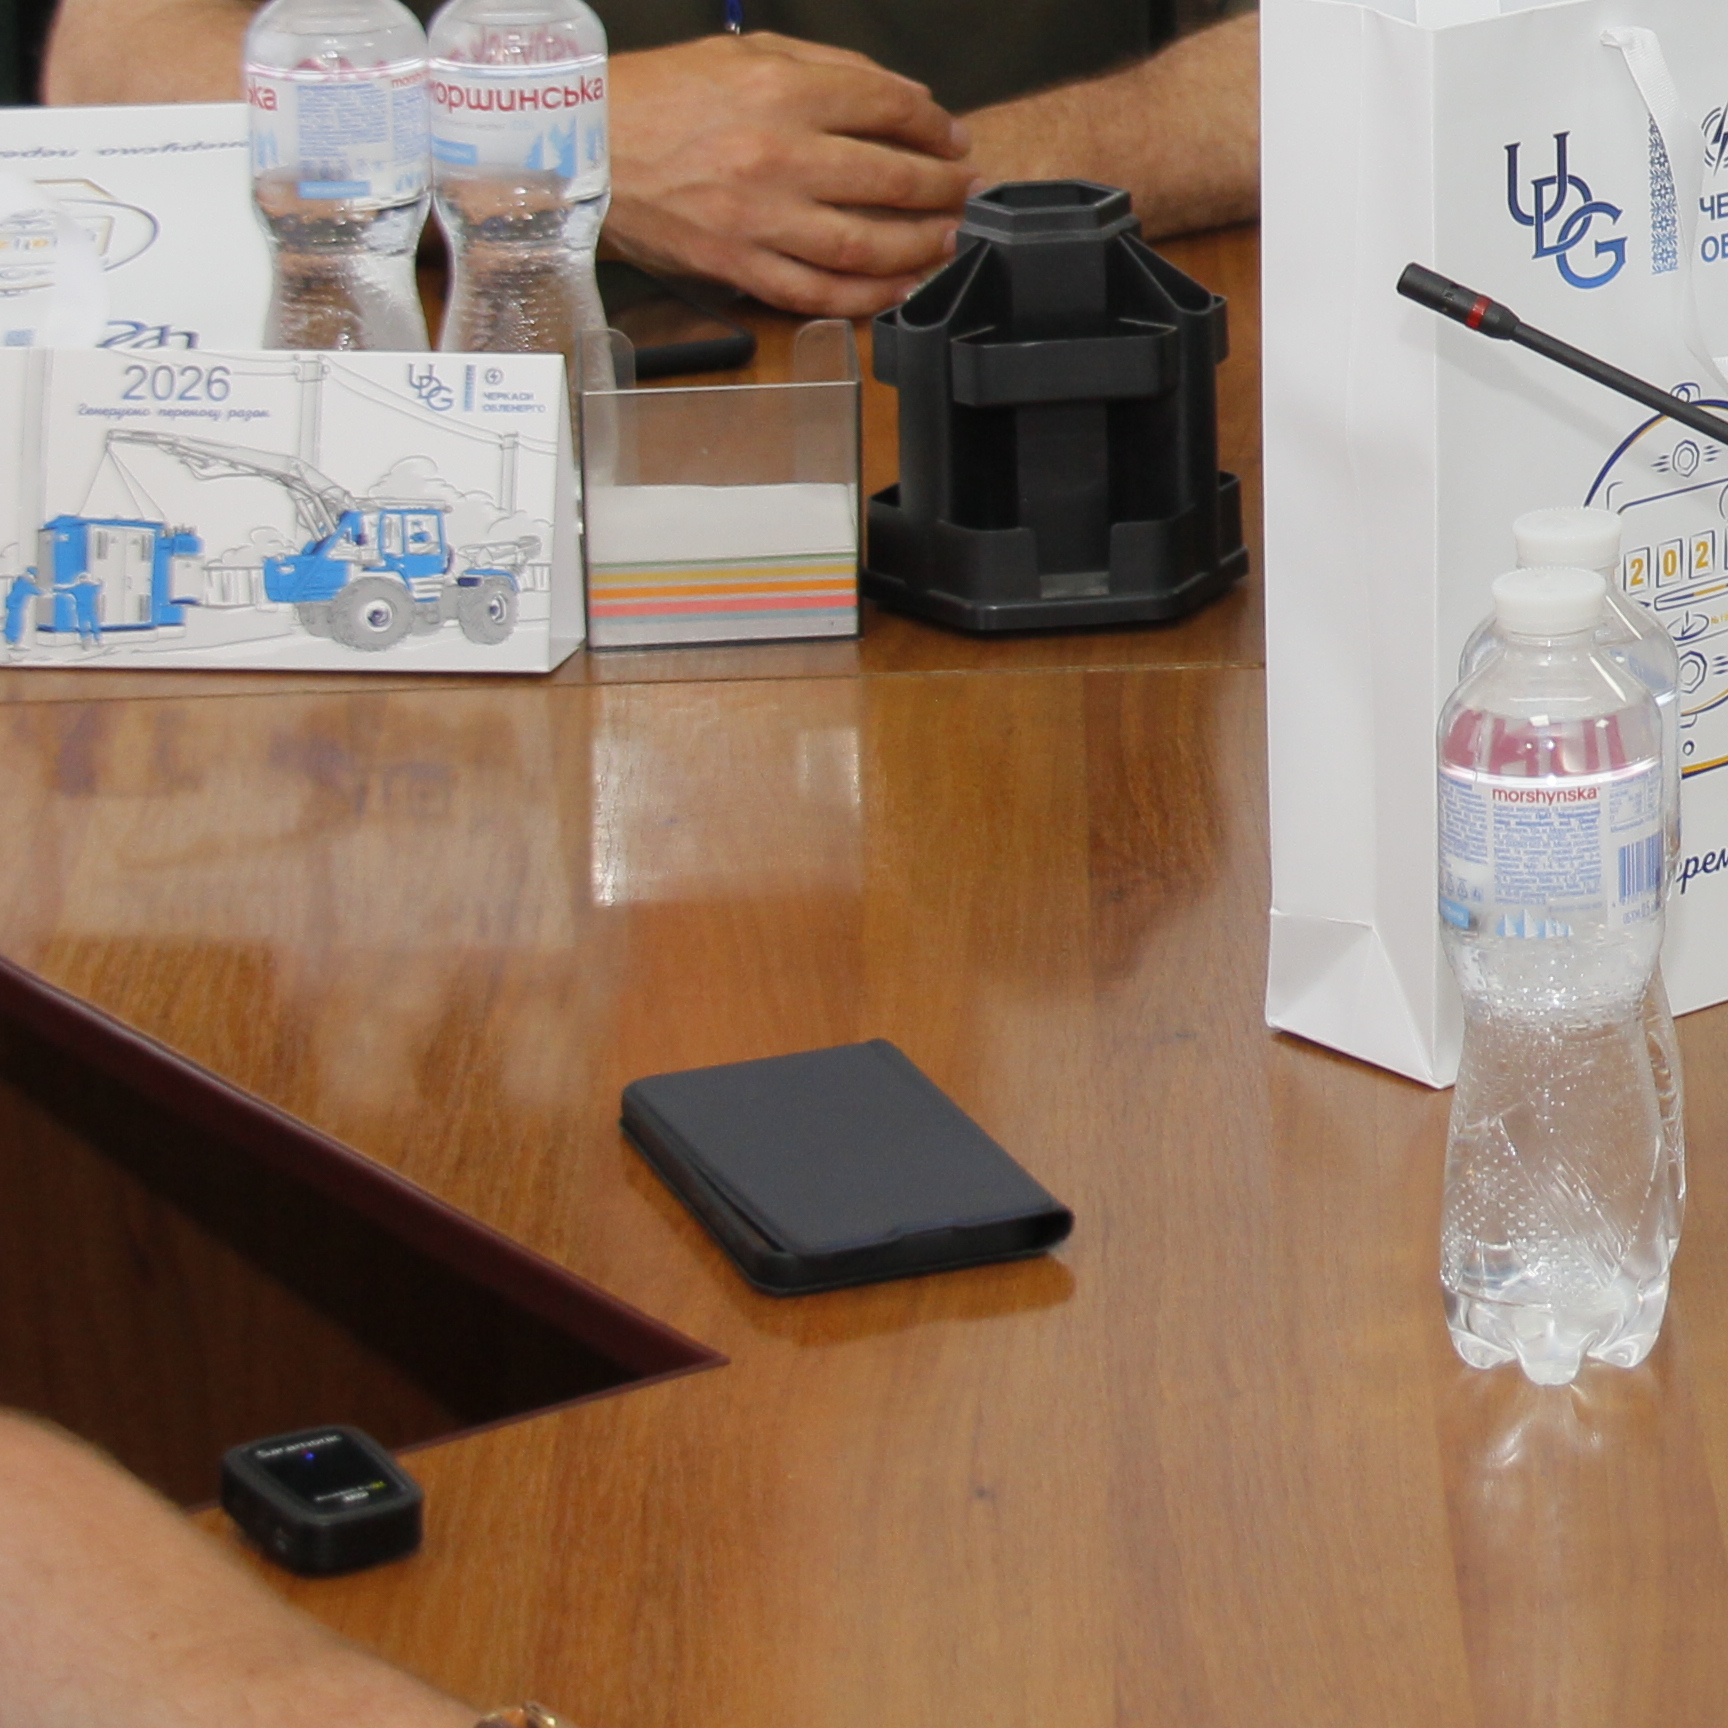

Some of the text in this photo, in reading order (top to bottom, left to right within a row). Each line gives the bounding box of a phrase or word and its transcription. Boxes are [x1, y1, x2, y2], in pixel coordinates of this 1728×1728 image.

[429, 76, 604, 114] оршинська
[1504, 131, 1628, 290] UDG
[122, 364, 232, 402] 2026
[484, 392, 534, 401] ЧЕРКАСИ
[483, 404, 547, 413] ОБЛЕНЕРГО
[1492, 786, 1598, 805] morshynska
